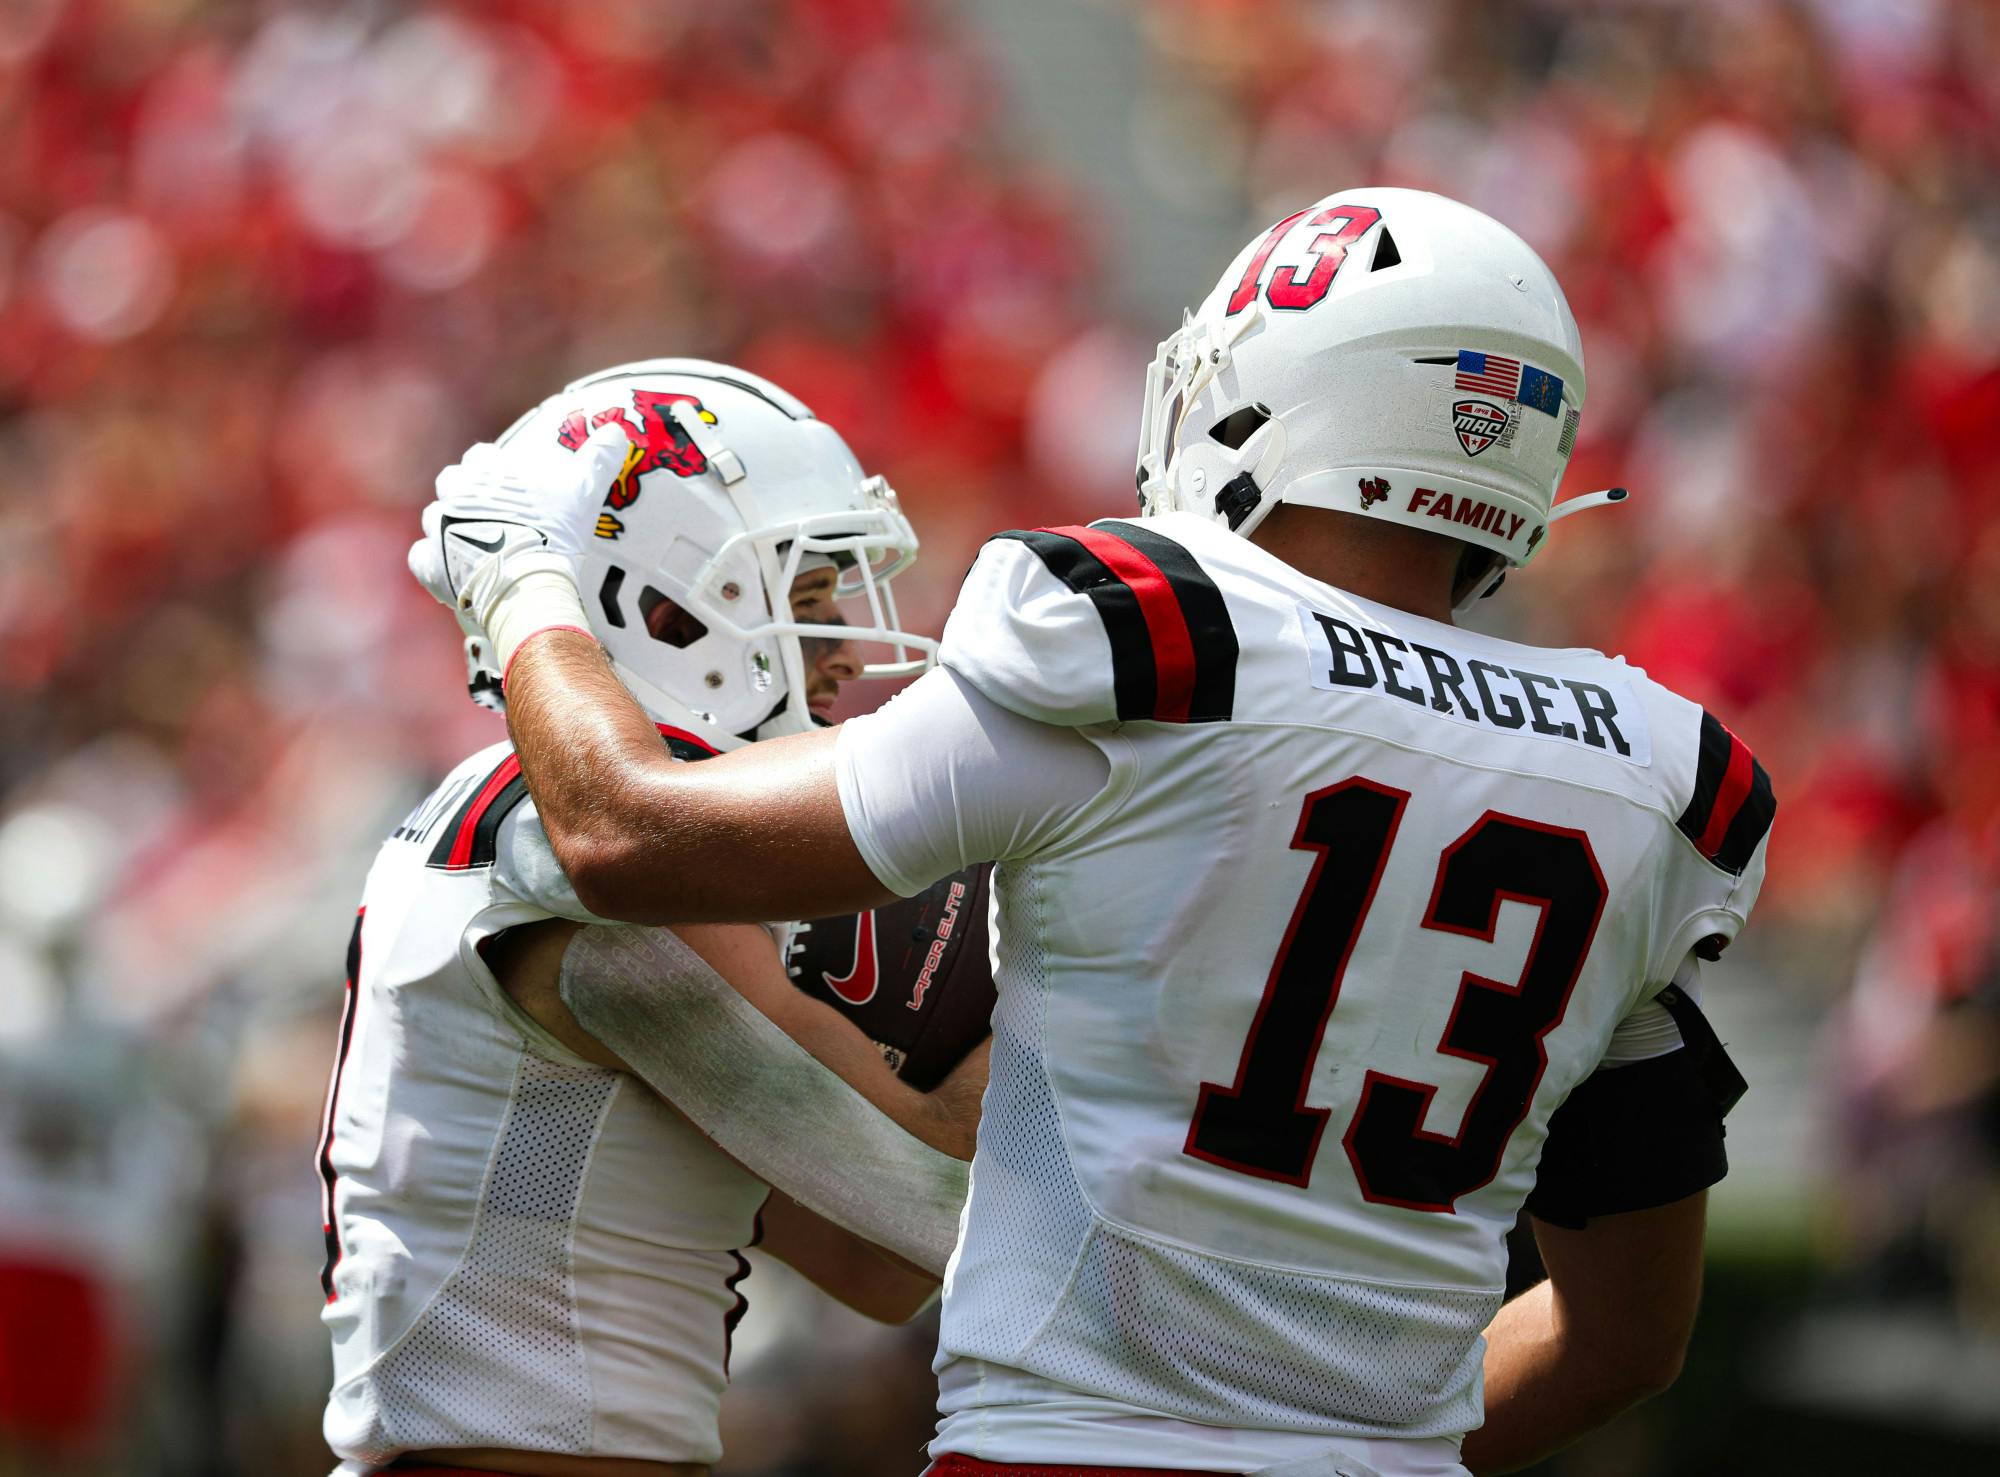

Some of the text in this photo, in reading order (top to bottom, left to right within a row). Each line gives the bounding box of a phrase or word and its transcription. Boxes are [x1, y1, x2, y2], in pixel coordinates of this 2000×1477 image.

[1225, 205, 1383, 317] 13
[1454, 414, 1503, 435] MAC
[1406, 487, 1526, 541] FAMILY
[1313, 612, 1631, 757] BERGER
[907, 882, 965, 1011] VAPOR ELITE
[1184, 775, 1609, 1214] 13
